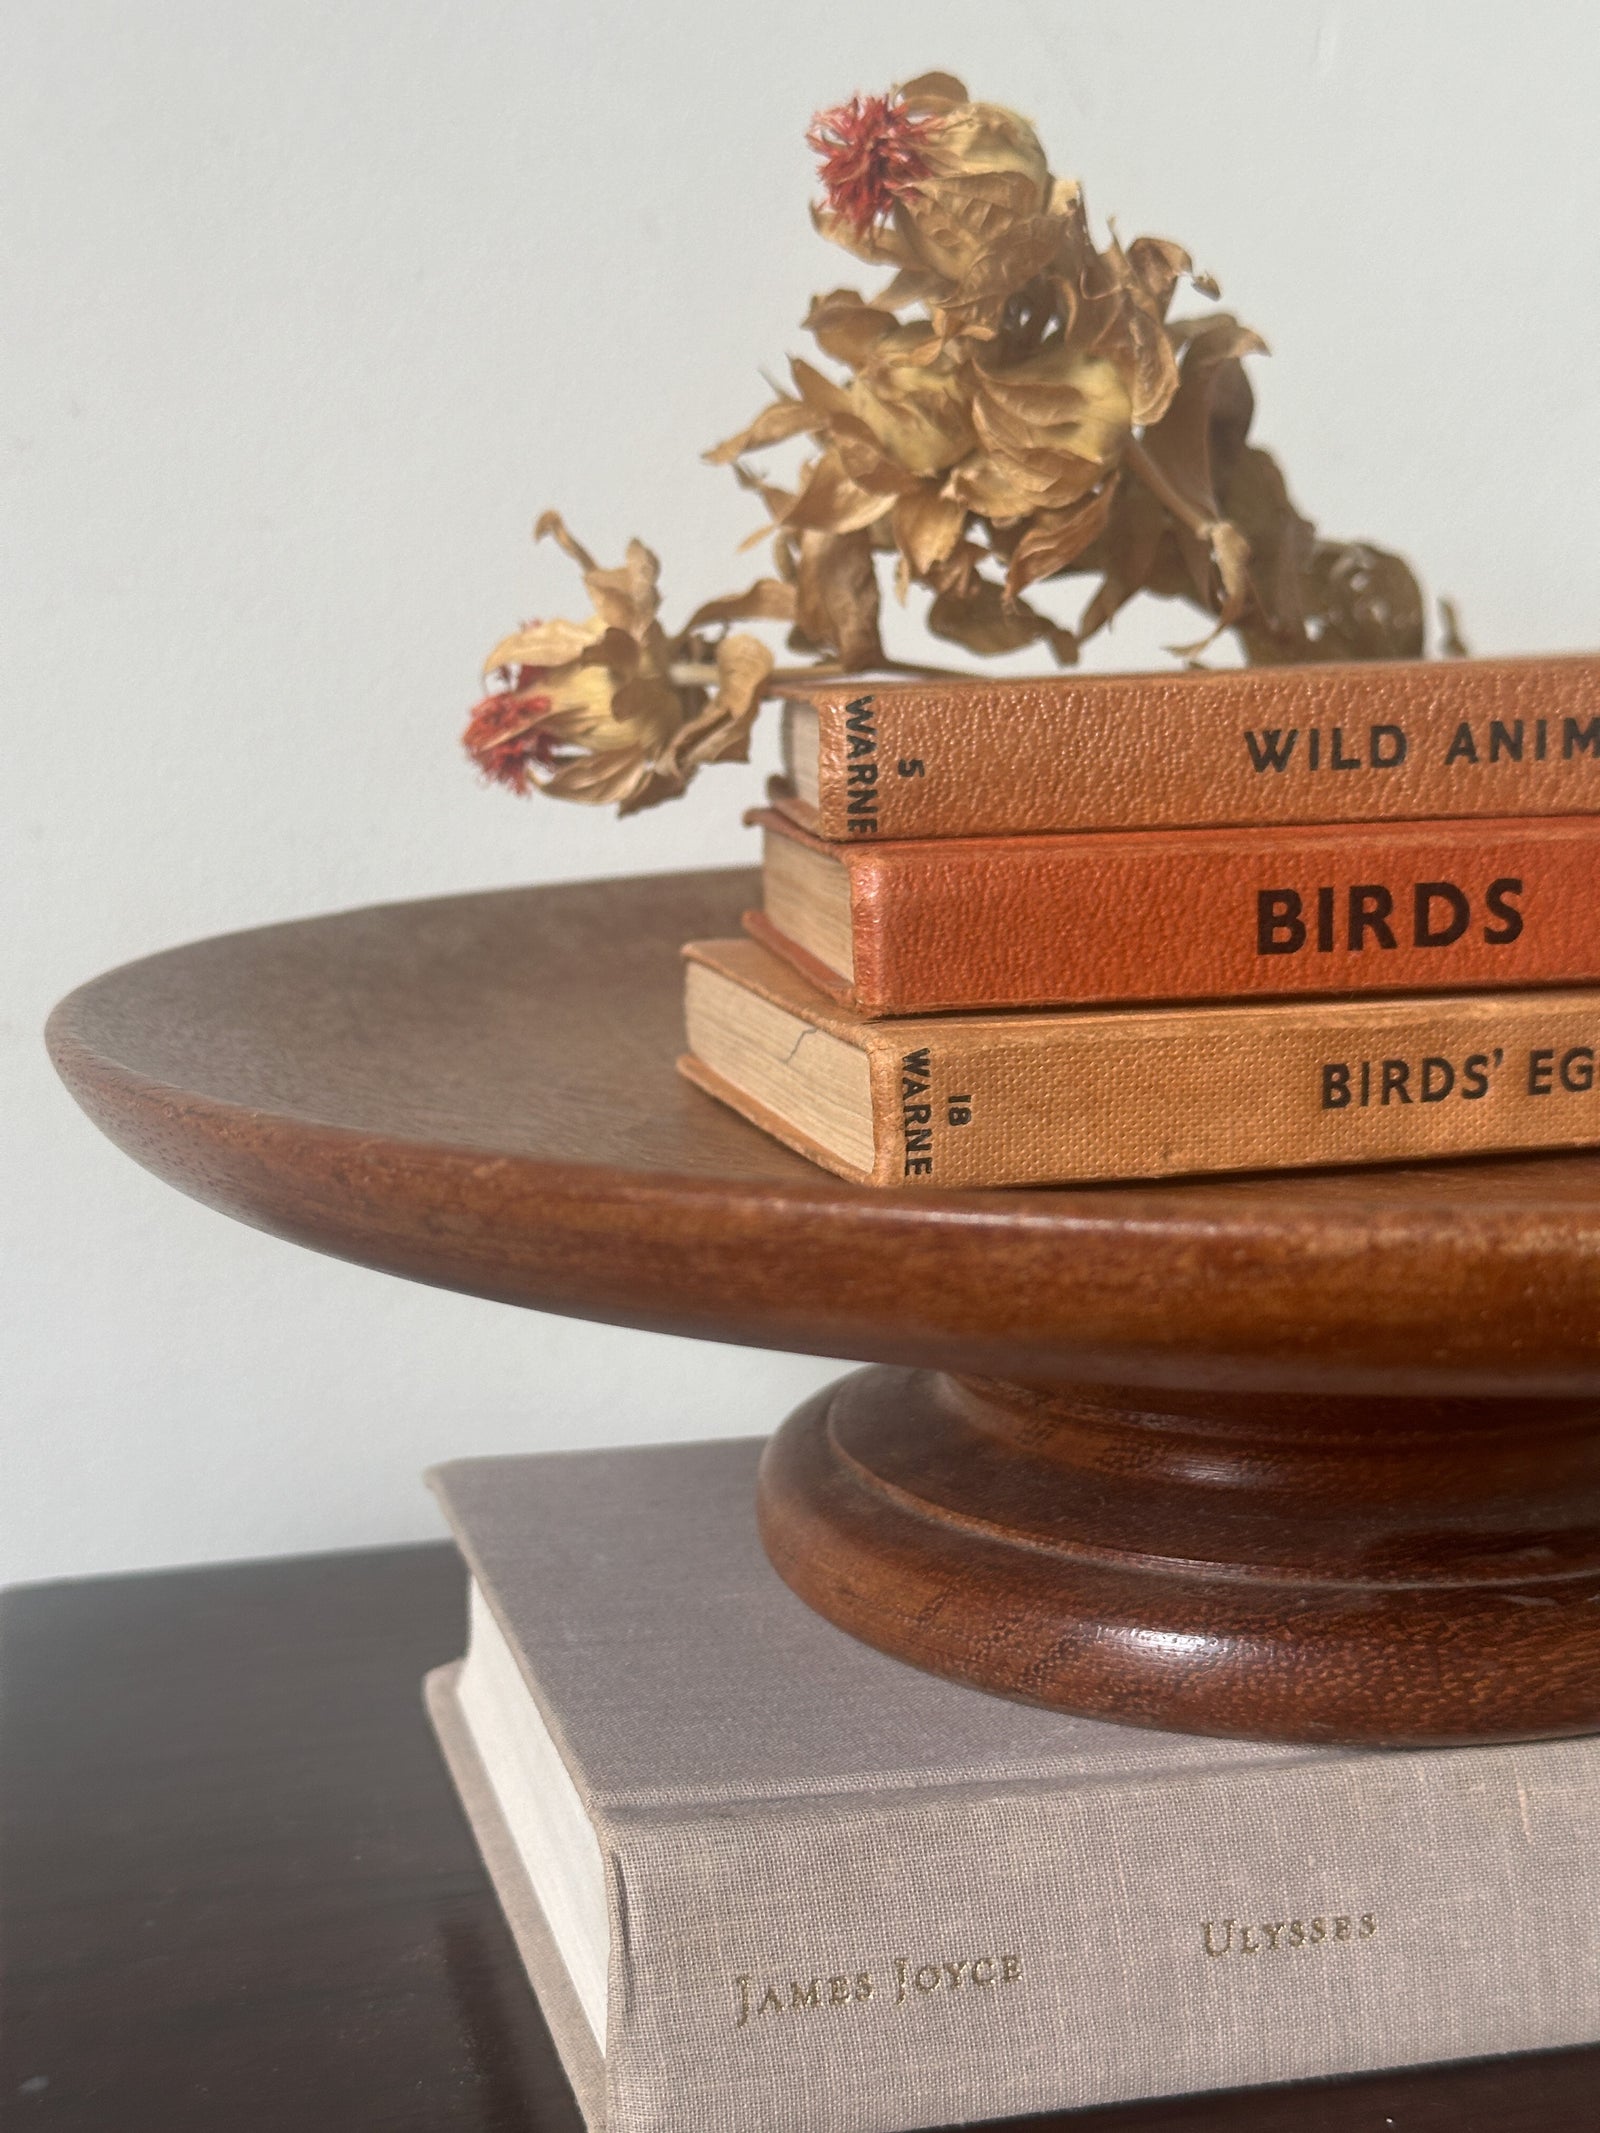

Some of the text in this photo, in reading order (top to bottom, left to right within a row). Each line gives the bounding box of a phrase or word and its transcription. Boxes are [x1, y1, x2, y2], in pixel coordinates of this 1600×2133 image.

[846, 696, 878, 834] WARNE
[898, 759, 925, 778] 5
[1245, 716, 1600, 773] WILD ANIM
[1257, 878, 1524, 955] BIRDS
[947, 1094, 971, 1126] 18
[1321, 1048, 1504, 1110] BIRDS'
[902, 1047, 932, 1177] WARNE
